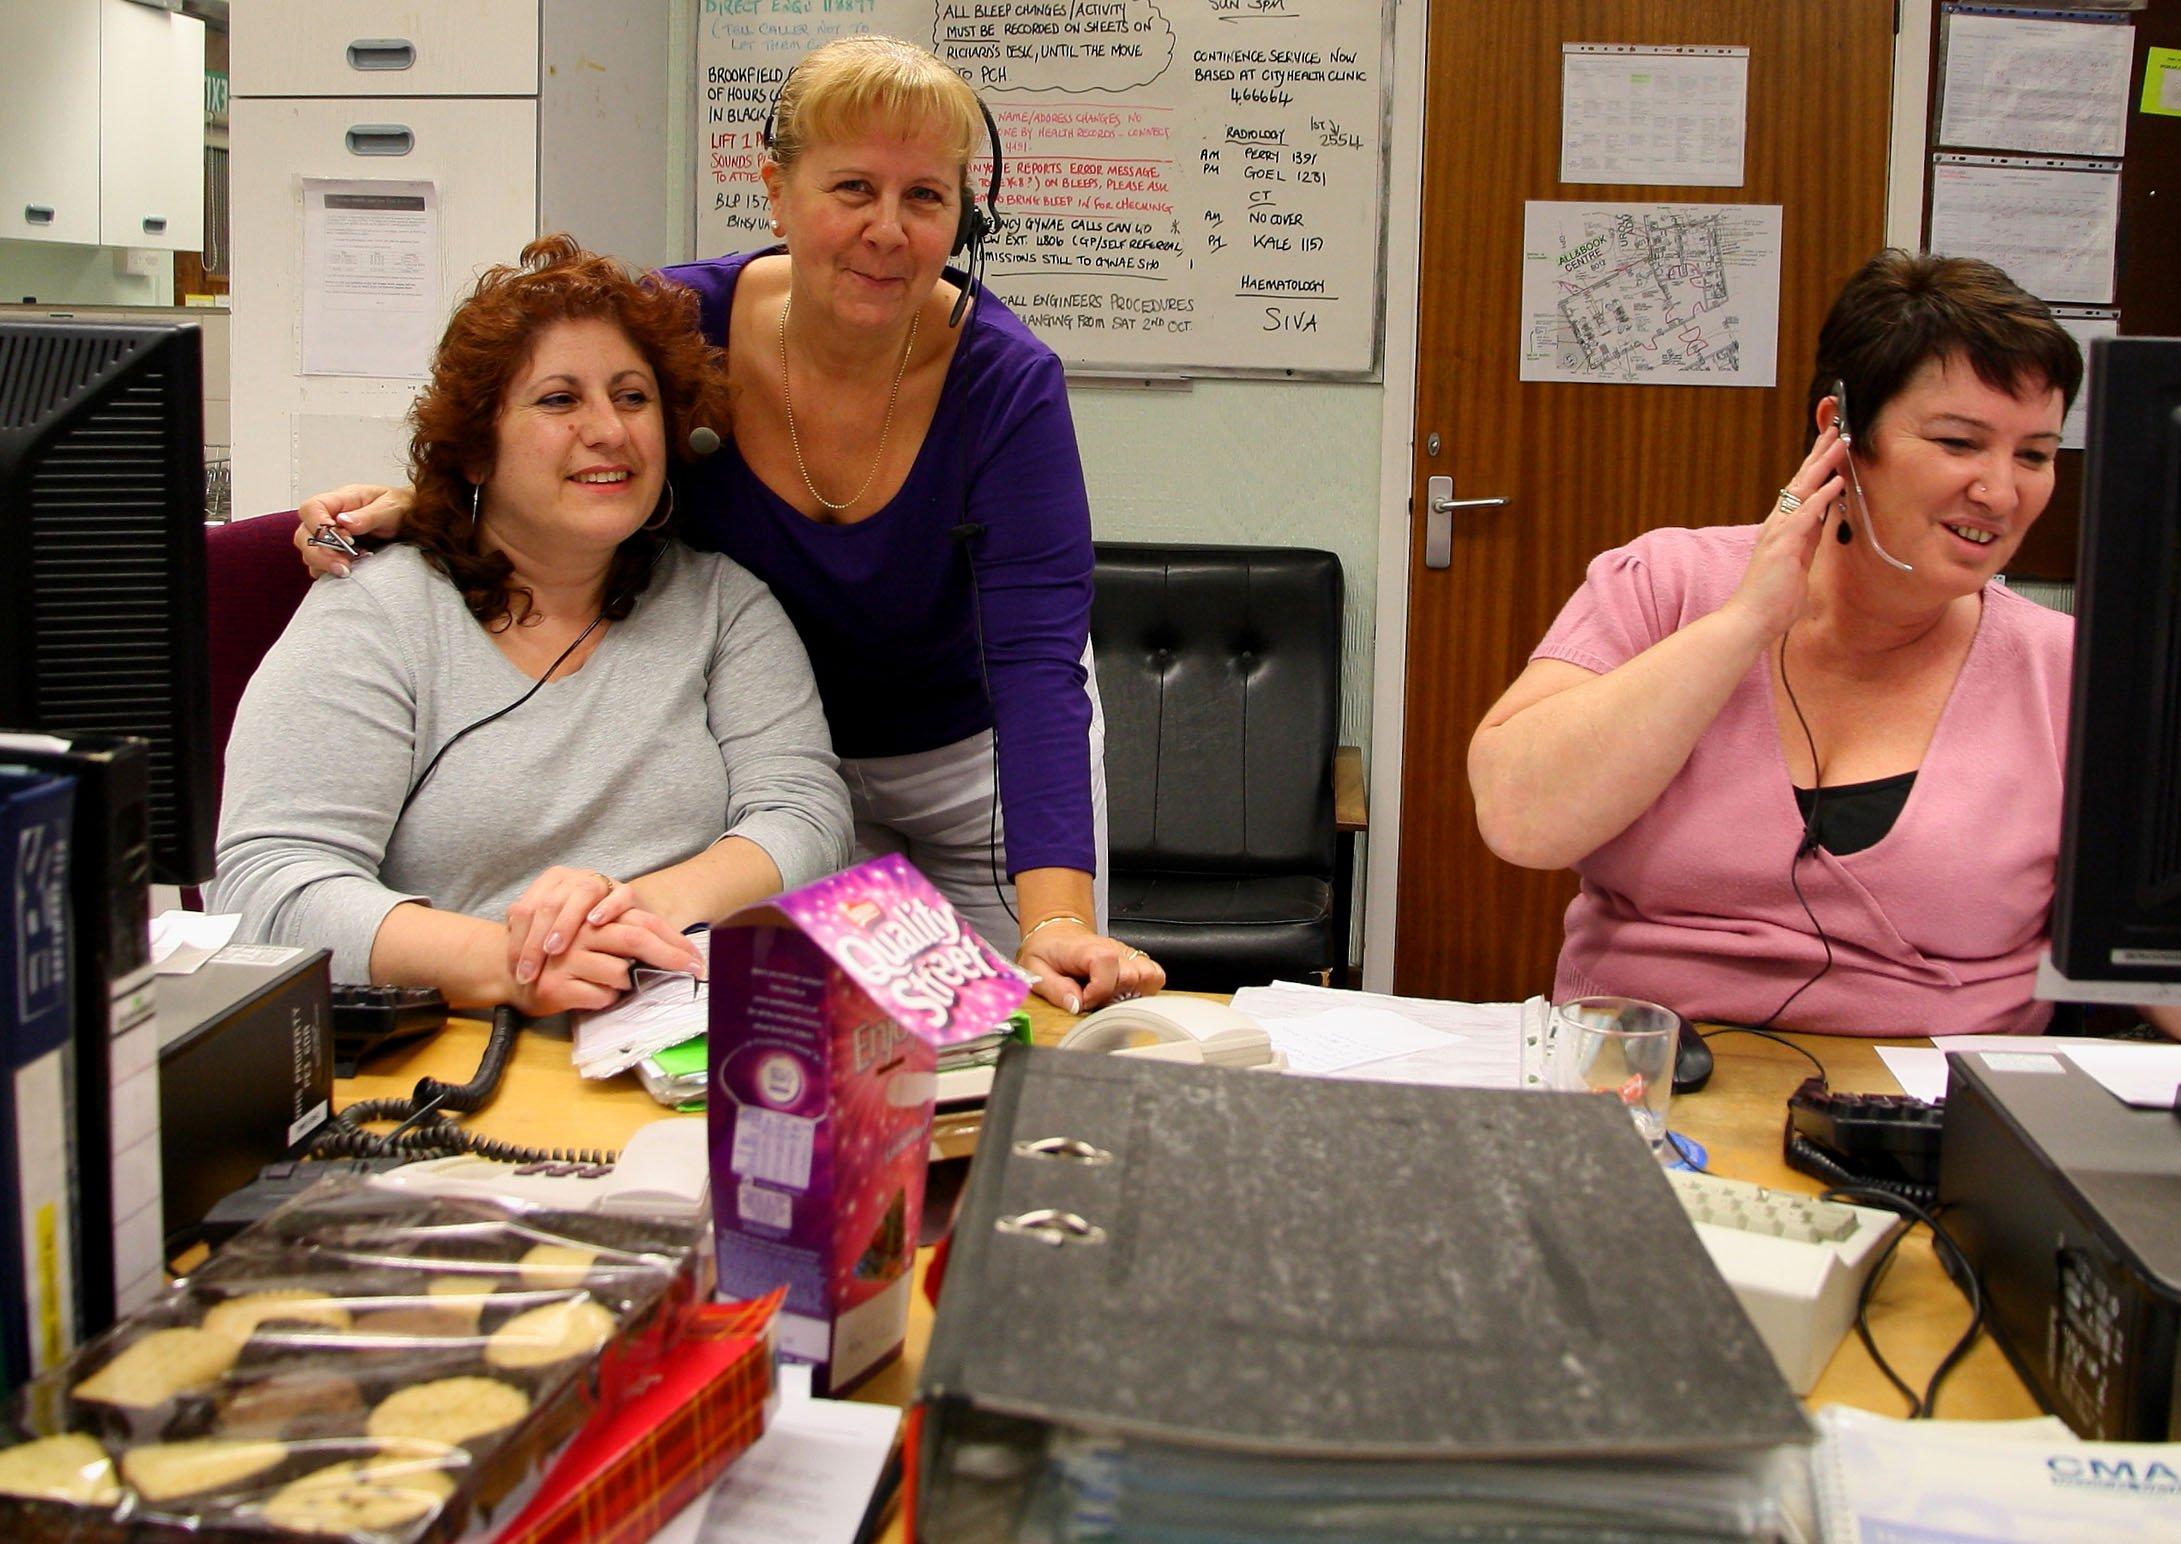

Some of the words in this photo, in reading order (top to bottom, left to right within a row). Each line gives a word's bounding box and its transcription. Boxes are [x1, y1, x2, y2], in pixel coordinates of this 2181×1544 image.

[943, 4, 970, 20] ALL
[974, 3, 1012, 18] BLEEP
[947, 26, 976, 38] MUST
[980, 23, 995, 37] BE
[1004, 22, 1060, 35] RECORDED
[1064, 22, 1081, 34] ON
[1084, 20, 1129, 33] SHEETS
[1134, 15, 1154, 32] ON
[1041, 43, 1079, 58] UNTIL
[1080, 43, 1106, 57] THE
[1111, 43, 1143, 57] MOVE
[1194, 50, 1266, 64] CONTINENCE
[1268, 49, 1321, 64] SERVICE
[708, 66, 783, 84] BROOKFIELD
[981, 65, 1007, 84] PCH
[1195, 69, 1235, 82] BASED
[1239, 69, 1257, 81] AT
[1287, 70, 1325, 82] HEALTH
[1328, 71, 1367, 82] CLINIC
[707, 87, 724, 101] OF
[727, 86, 766, 103] HOURS
[709, 105, 723, 123] IN
[727, 107, 767, 123] BLACK
[711, 132, 737, 149] LIFT
[742, 133, 752, 149] 1
[1021, 127, 1032, 140] BY
[1039, 127, 1073, 139] HEALTH
[1076, 128, 1116, 138] RECORDS
[1226, 126, 1285, 144] RADIOLOGY
[1320, 133, 1364, 150] 2554
[711, 152, 752, 169] SOUNDS
[1200, 149, 1220, 161] AM
[1245, 148, 1280, 163] PERRY
[712, 170, 726, 184] TO
[729, 171, 762, 184] ATTE
[1017, 162, 1062, 175] REPORTS
[1070, 162, 1104, 176] ERROR
[1203, 164, 1220, 176] PM
[1244, 166, 1286, 182] GOEL
[1045, 178, 1058, 188] ON
[1106, 179, 1144, 191] PLEASE
[1147, 181, 1169, 192] ASK
[1250, 191, 1273, 202] CT
[1043, 196, 1073, 207] BLEEP
[1079, 196, 1091, 208] IN
[1115, 197, 1174, 215] CHECKING
[1026, 218, 1064, 232] GYNAE
[1071, 219, 1103, 232] CALLS
[1106, 221, 1131, 234] CAN
[1250, 212, 1267, 223] NO
[1271, 213, 1304, 227] COVER
[1036, 235, 1064, 246] 4806
[1254, 235, 1291, 250] KALE
[981, 251, 1036, 263] MISSIONS
[1042, 254, 1072, 266] STILL
[1076, 255, 1092, 267] TO
[1095, 257, 1134, 269] GYNAE
[1564, 248, 1602, 272] CENTRE
[1241, 274, 1325, 293] HAEMATOLOGY
[1033, 293, 1103, 308] ENGINEERS
[1110, 293, 1194, 313] PROCEDURES
[1112, 316, 1136, 330] SAT
[1142, 316, 1164, 331] 2ND
[1263, 307, 1317, 332] SIVA
[837, 898, 960, 985] Quality
[890, 935, 998, 1028] Street
